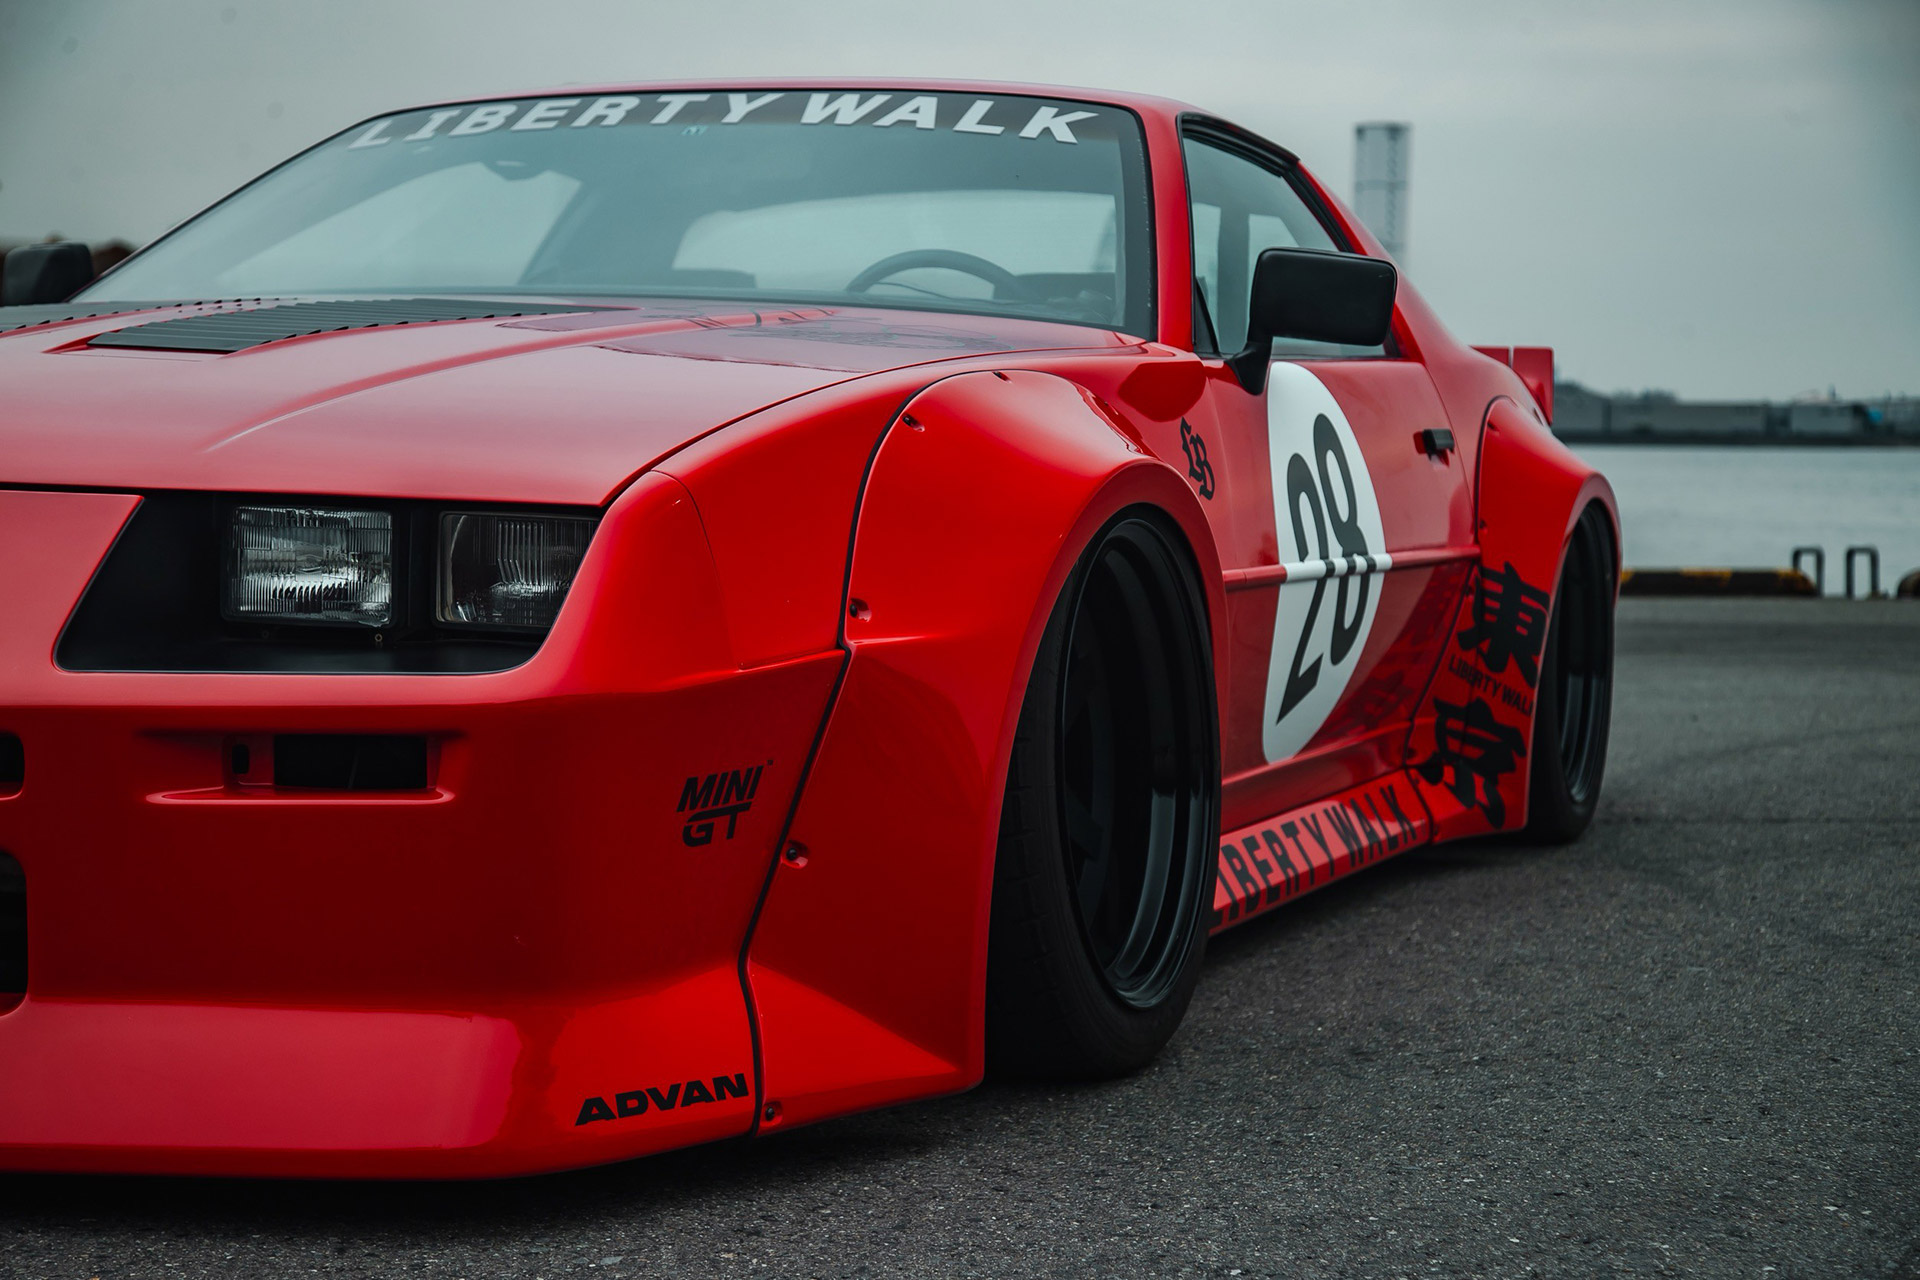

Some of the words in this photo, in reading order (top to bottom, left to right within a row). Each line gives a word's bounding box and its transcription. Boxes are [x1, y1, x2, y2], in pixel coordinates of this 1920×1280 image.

[348, 93, 784, 150] LIBERTY
[800, 92, 1099, 144] WALK
[1276, 413, 1371, 725] 28
[1448, 653, 1502, 699] LIBERTY
[1502, 685, 1534, 716] WAL
[676, 765, 764, 813] MINI
[681, 801, 752, 848] GT
[1323, 785, 1417, 868] WALK
[574, 1072, 749, 1127] ADVAN
